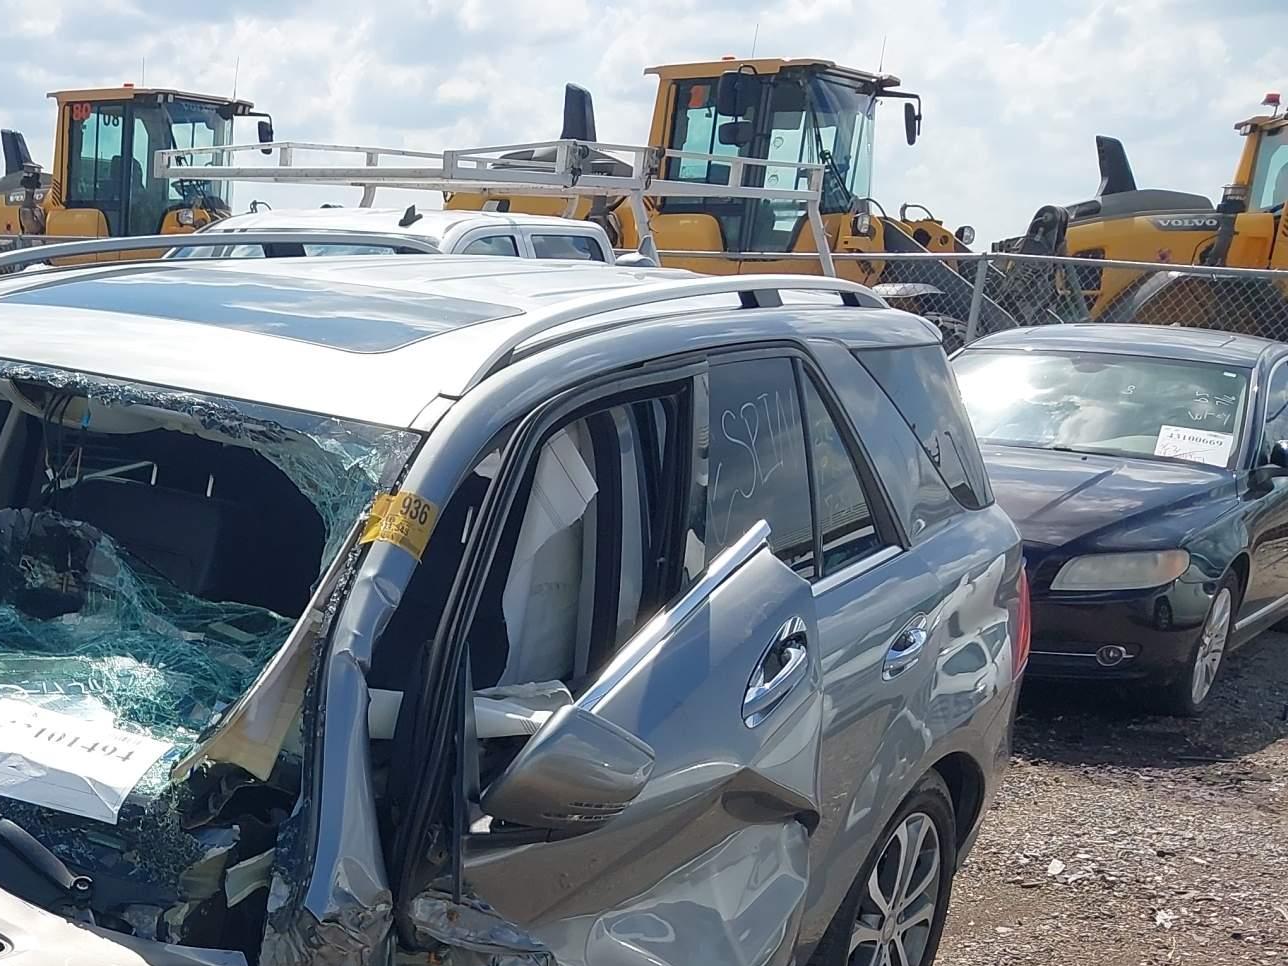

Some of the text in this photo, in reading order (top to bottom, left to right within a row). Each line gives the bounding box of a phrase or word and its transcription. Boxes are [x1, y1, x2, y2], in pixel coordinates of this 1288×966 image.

[72, 102, 92, 121] 80
[1158, 218, 1218, 227] VOLVO
[400, 496, 430, 525] 936
